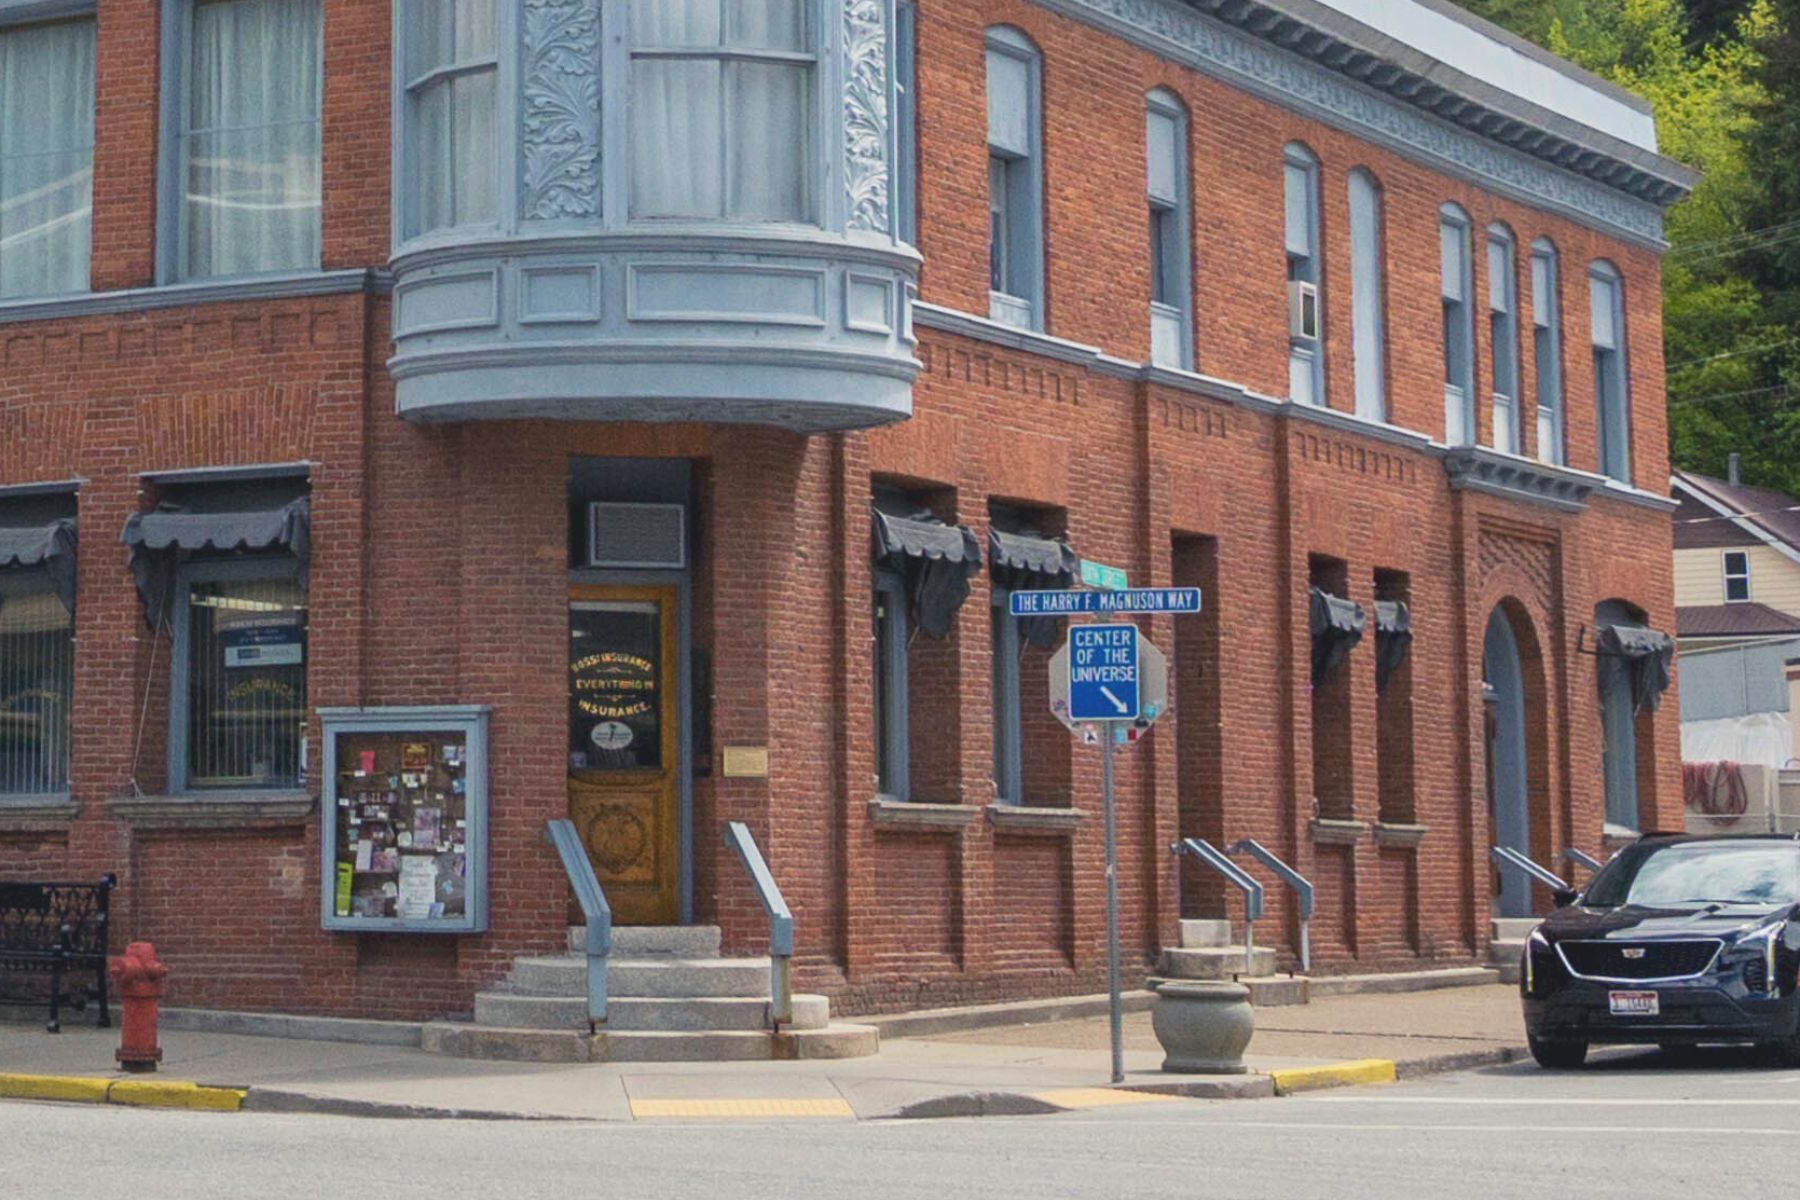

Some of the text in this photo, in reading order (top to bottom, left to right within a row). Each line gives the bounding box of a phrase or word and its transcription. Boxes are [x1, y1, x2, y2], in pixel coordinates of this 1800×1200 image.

[1018, 591, 1193, 611] THE HARRY F. MAGNUSON WAY
[1075, 629, 1132, 647] CENTER
[1076, 647, 1131, 665] OF THE
[1071, 666, 1137, 683] UNIVERSE
